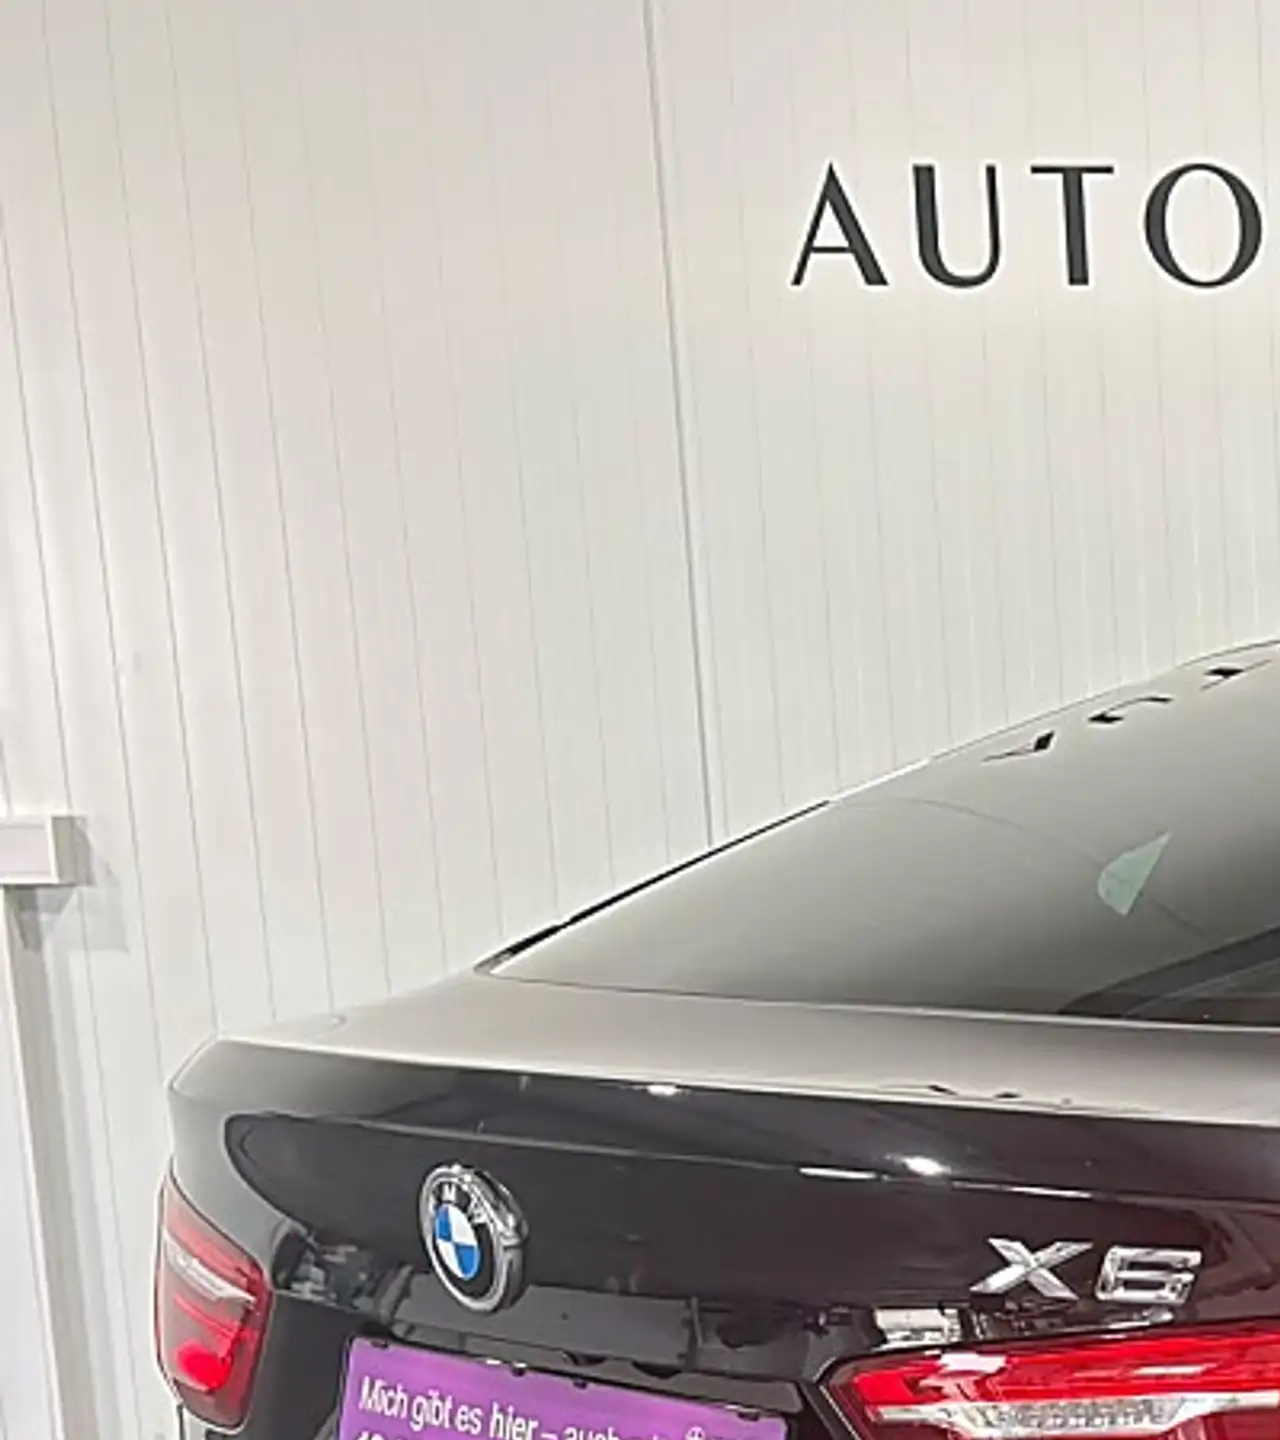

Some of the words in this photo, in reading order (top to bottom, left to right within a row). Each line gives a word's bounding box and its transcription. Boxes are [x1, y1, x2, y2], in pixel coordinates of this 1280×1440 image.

[969, 1237, 1202, 1305] X6
[358, 1375, 409, 1419] Mich
[410, 1388, 453, 1432] gibt
[455, 1404, 484, 1436] es
